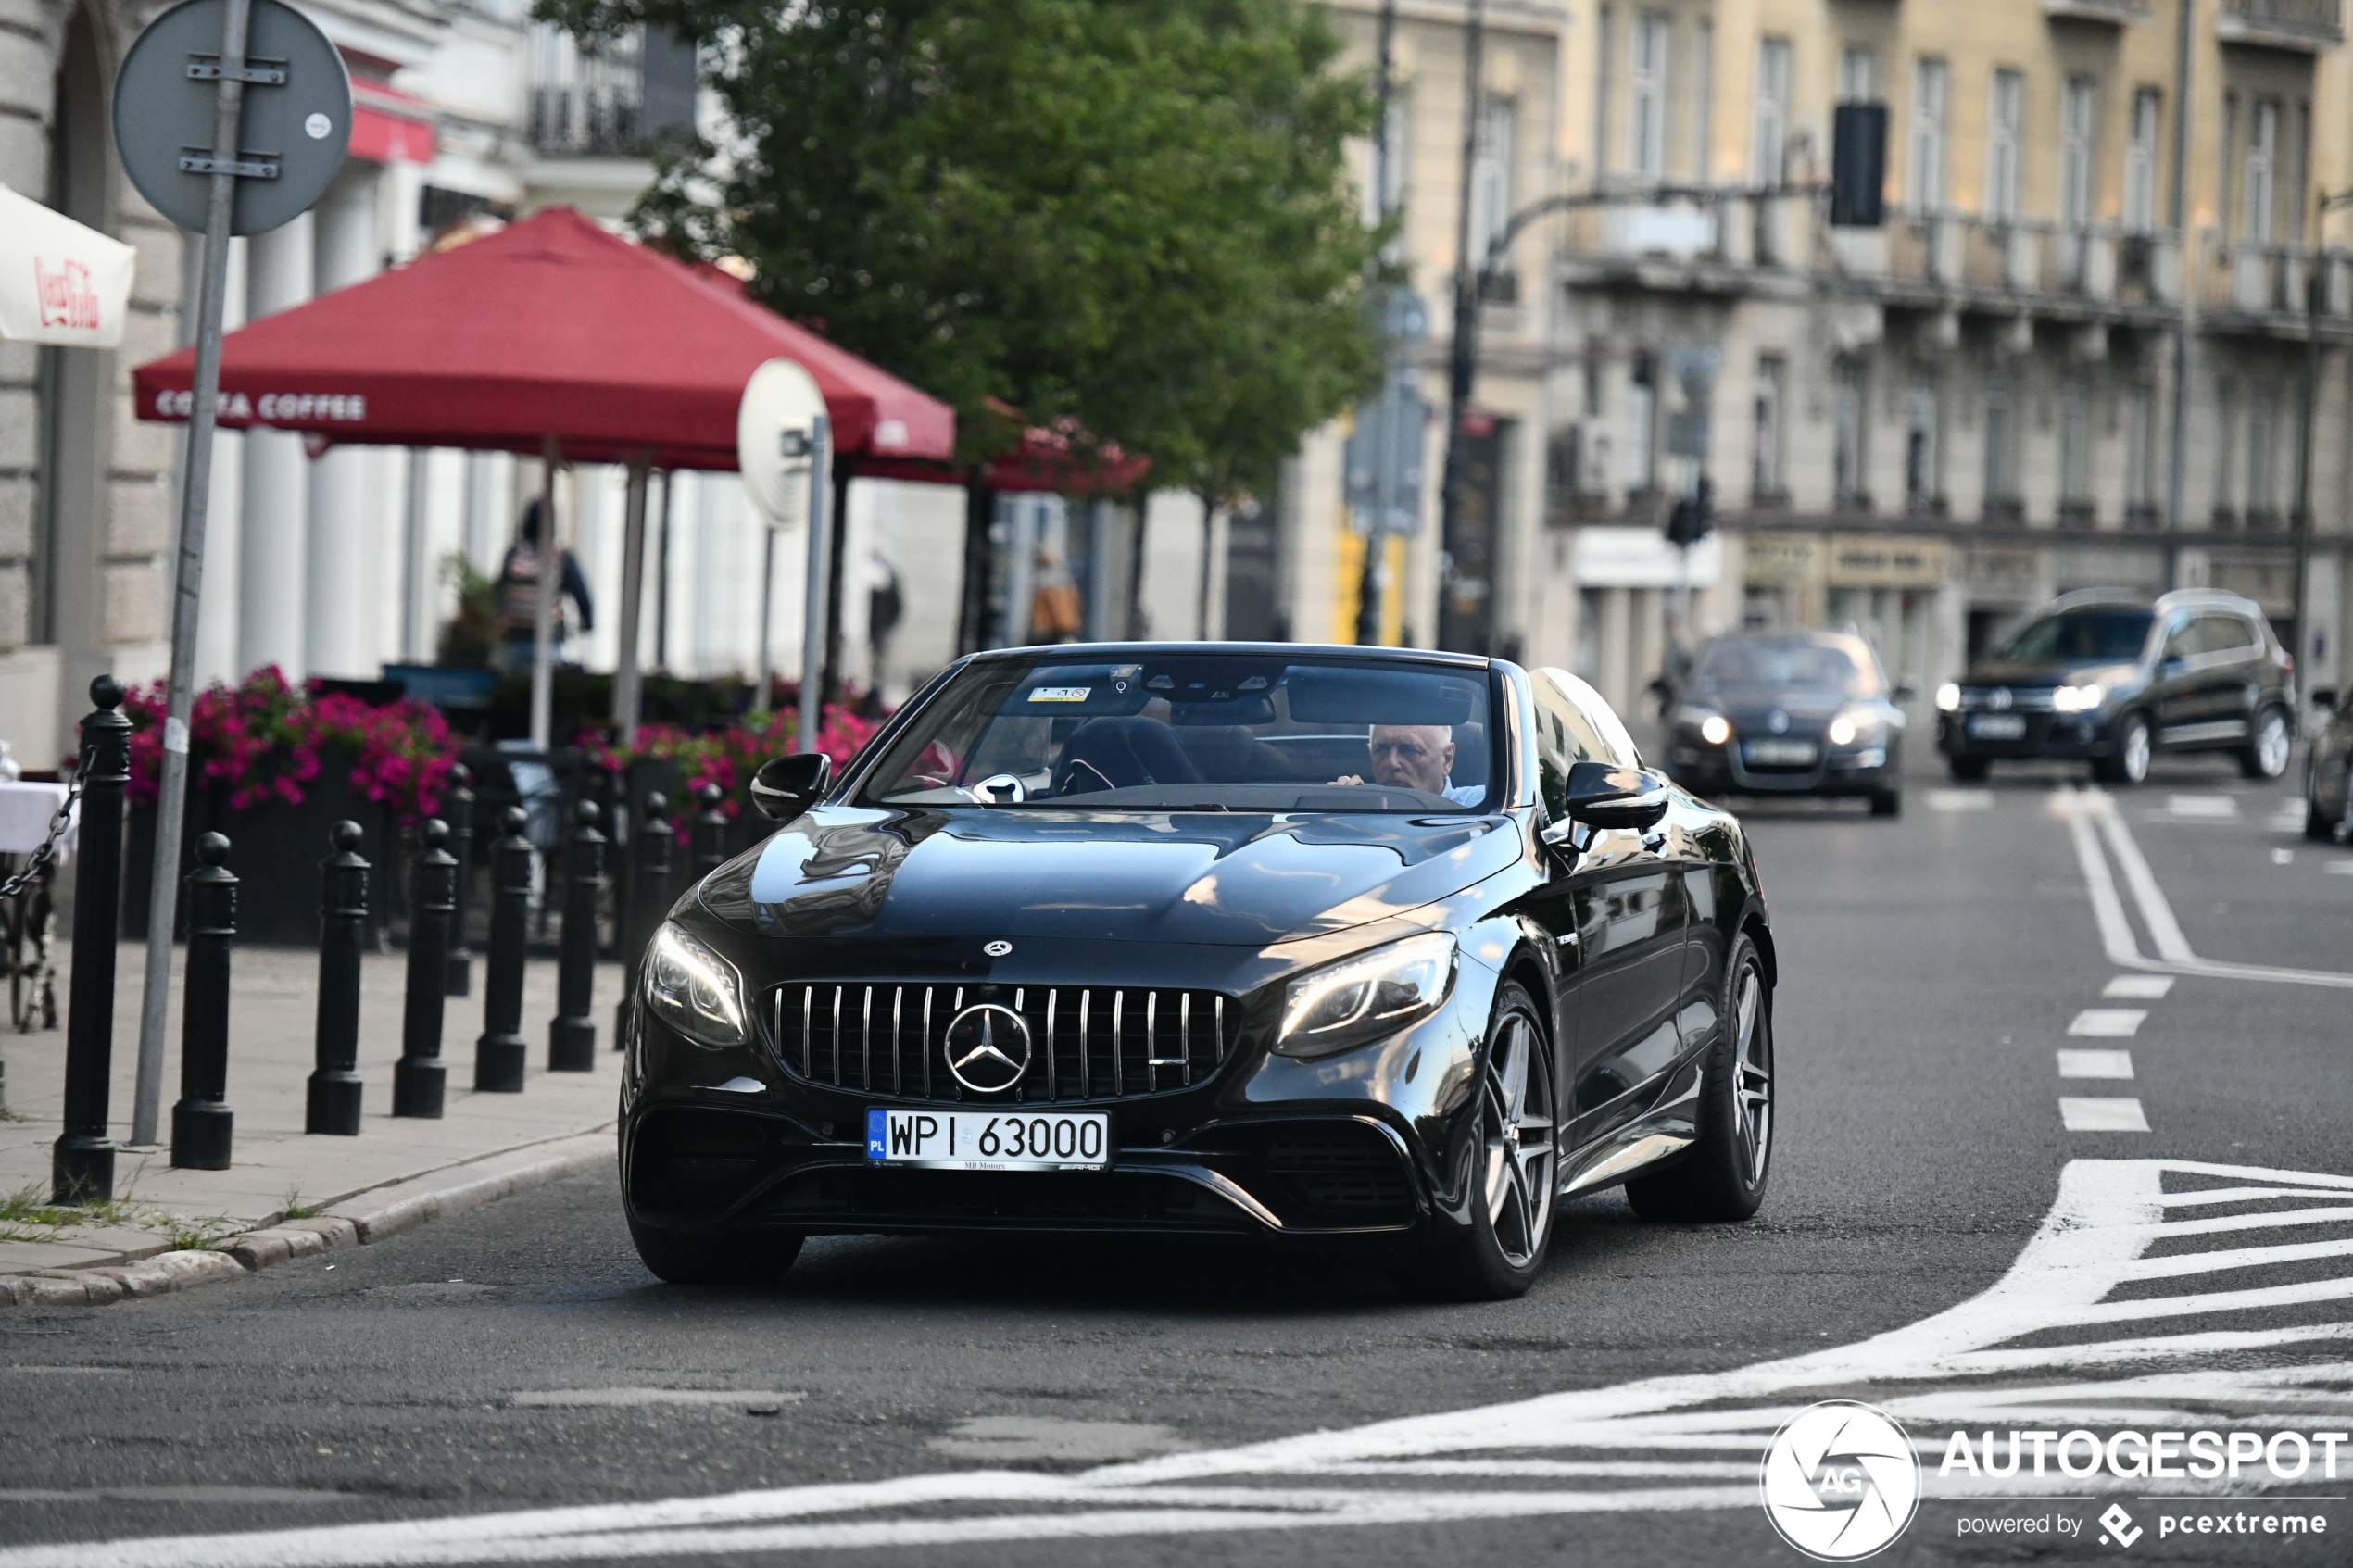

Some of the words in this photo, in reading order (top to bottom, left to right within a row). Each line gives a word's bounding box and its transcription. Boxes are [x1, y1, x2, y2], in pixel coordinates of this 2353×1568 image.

[155, 389, 252, 418] COTA
[258, 392, 365, 420] COFFEE
[870, 1140, 885, 1152] PL
[979, 1117, 1101, 1159] 63000
[979, 1161, 1006, 1170] Motors
